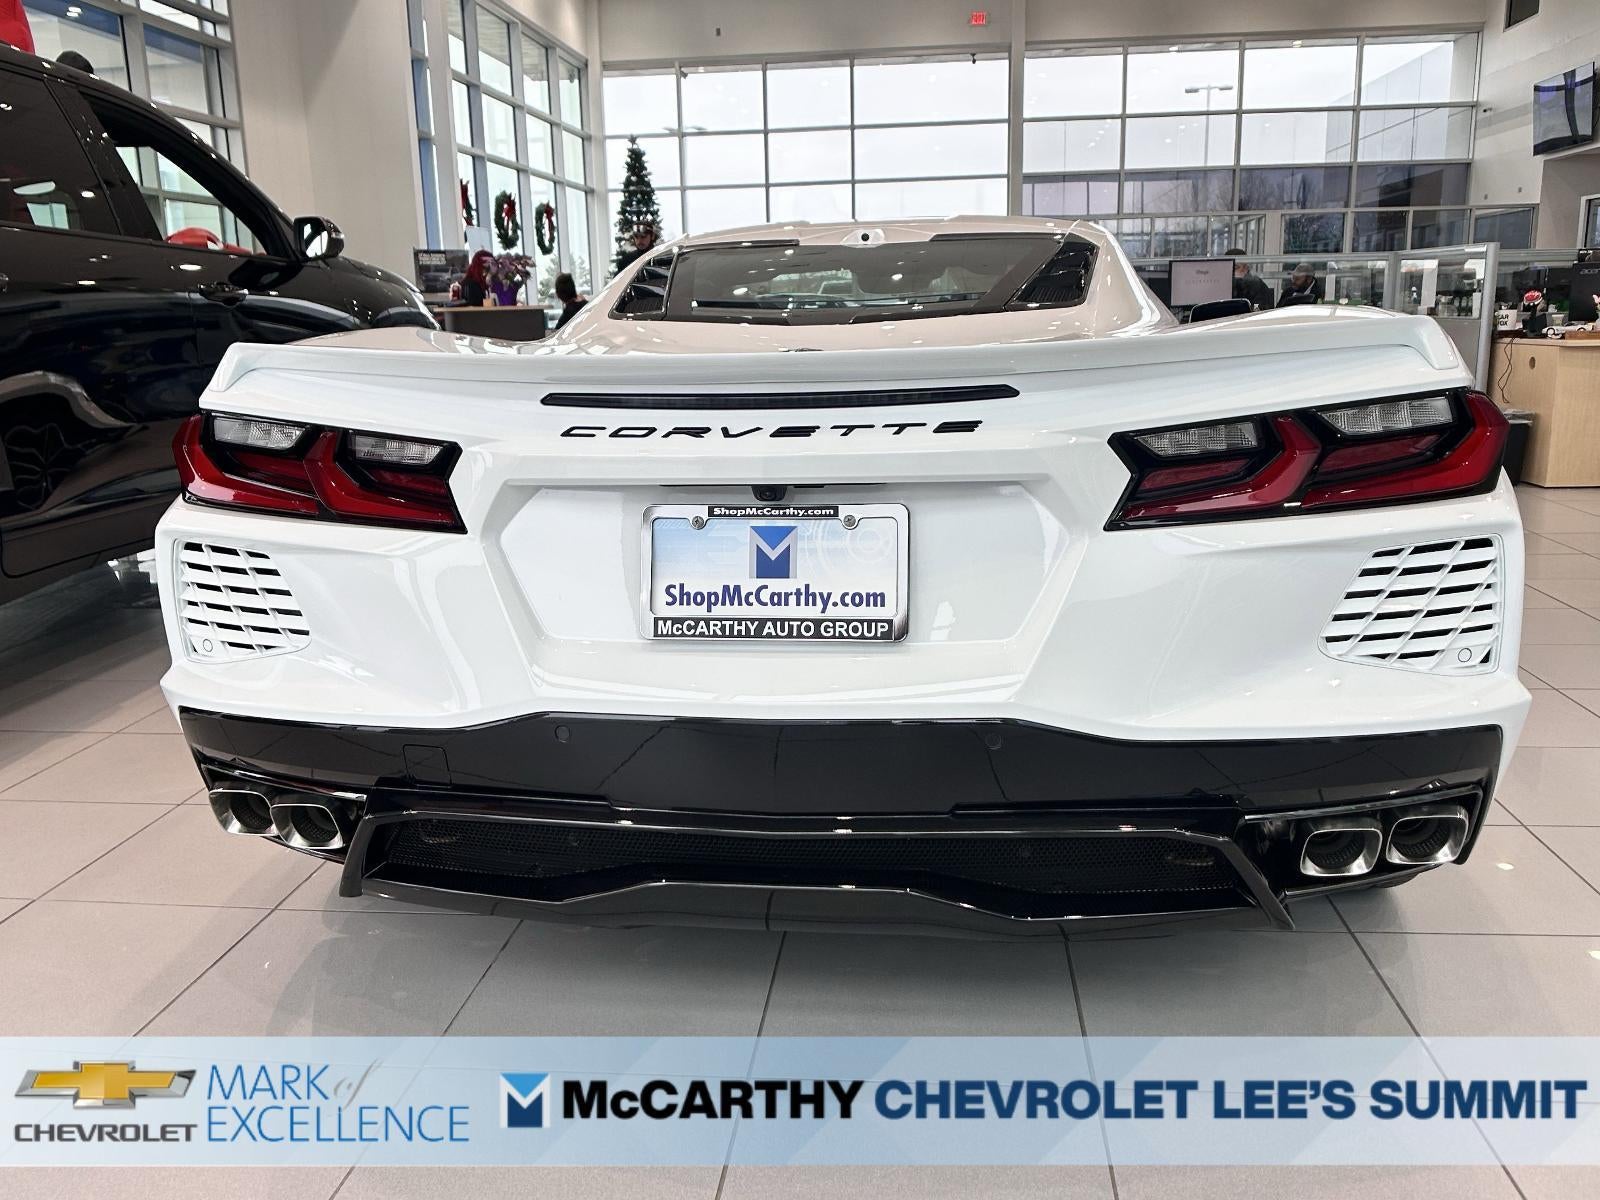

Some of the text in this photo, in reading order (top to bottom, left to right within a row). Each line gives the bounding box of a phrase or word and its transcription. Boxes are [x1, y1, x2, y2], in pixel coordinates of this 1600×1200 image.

[560, 420, 984, 439] CORVETTE
[713, 506, 834, 517] ShopMcCarthy.com
[664, 583, 886, 614] ShopMcCarthy.com
[657, 620, 889, 638] McCARTHY AUTO GROUP
